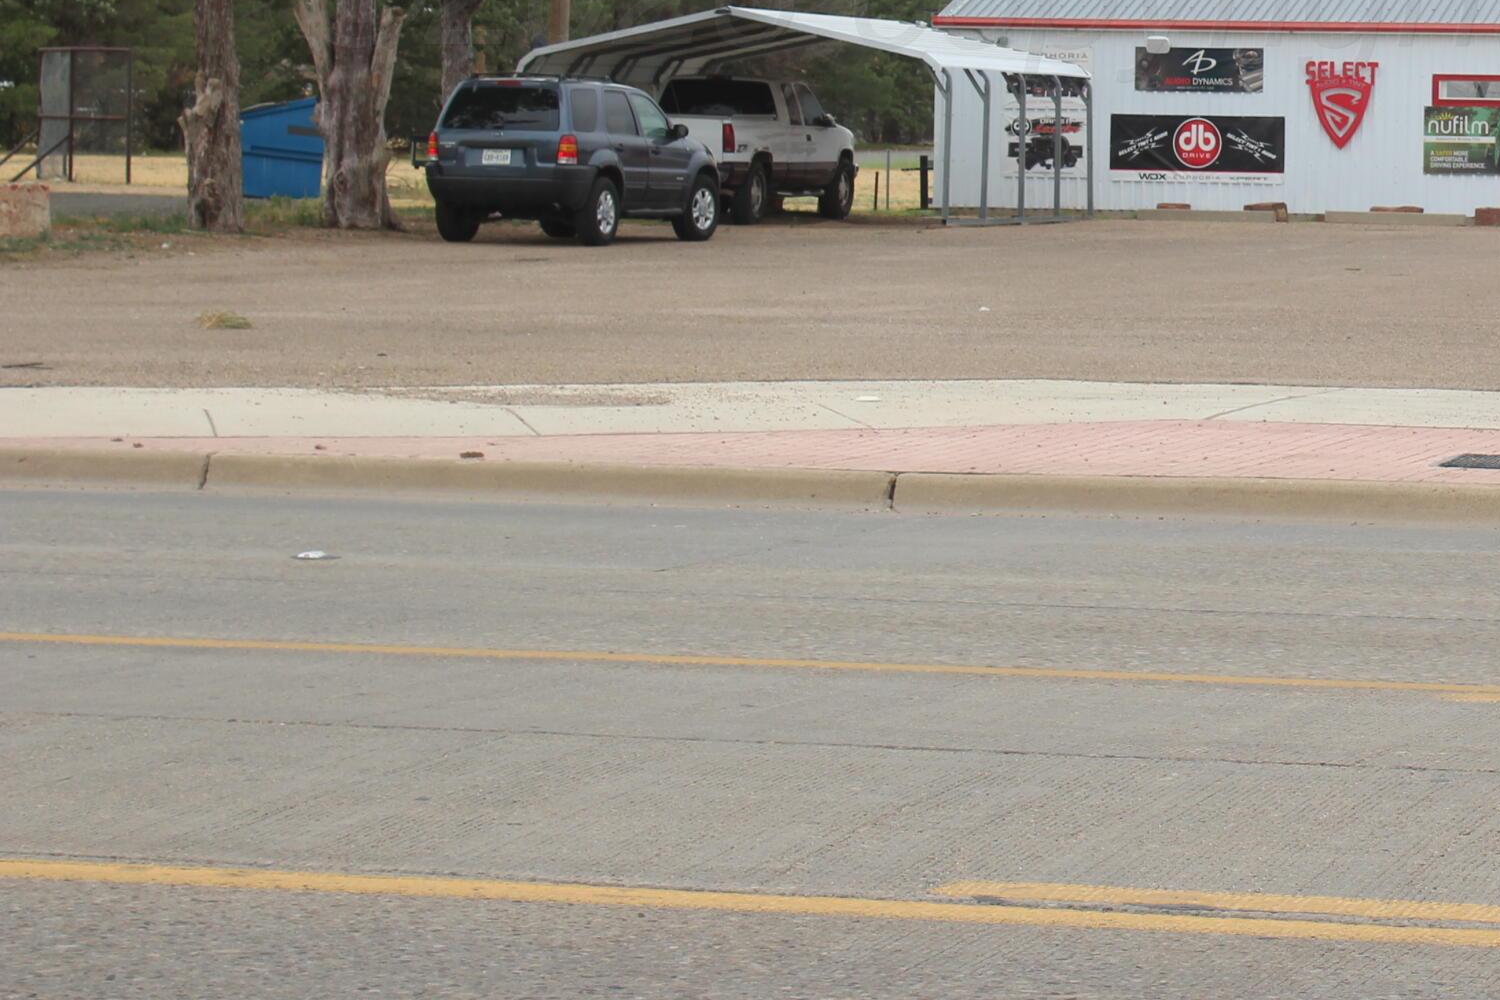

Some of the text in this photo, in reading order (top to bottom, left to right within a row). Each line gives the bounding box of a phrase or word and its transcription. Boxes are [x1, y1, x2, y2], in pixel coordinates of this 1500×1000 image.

[1192, 77, 1233, 86] DYNAMICS
[1305, 61, 1379, 86] SELECT
[1428, 115, 1489, 135] nufilm
[1179, 124, 1216, 151] db
